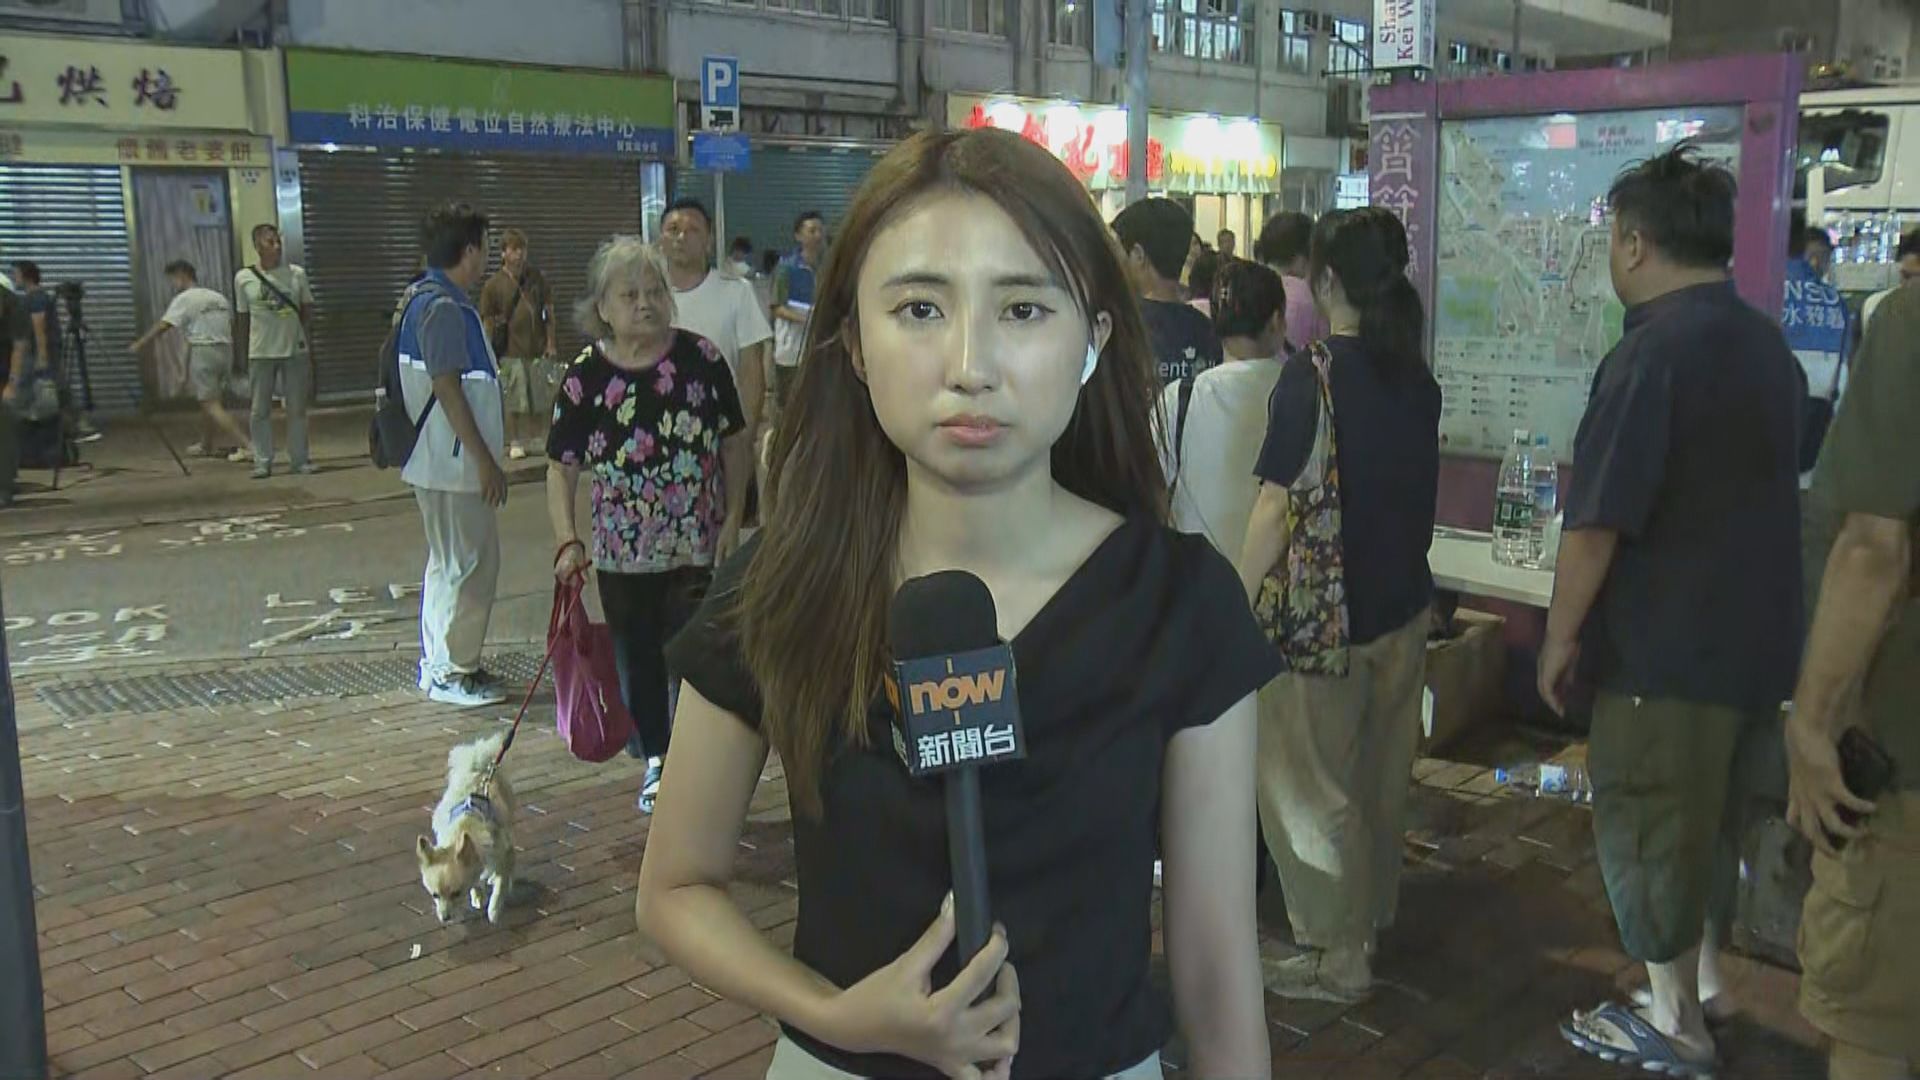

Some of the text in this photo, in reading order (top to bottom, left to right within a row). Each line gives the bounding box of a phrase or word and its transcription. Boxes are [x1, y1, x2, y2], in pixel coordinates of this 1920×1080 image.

[1397, 27, 1414, 60] Kei
[708, 62, 732, 103] P
[348, 102, 636, 139] 科治保健電位自然療法中心
[910, 669, 1005, 715] now
[918, 724, 1015, 769] 新聞台
